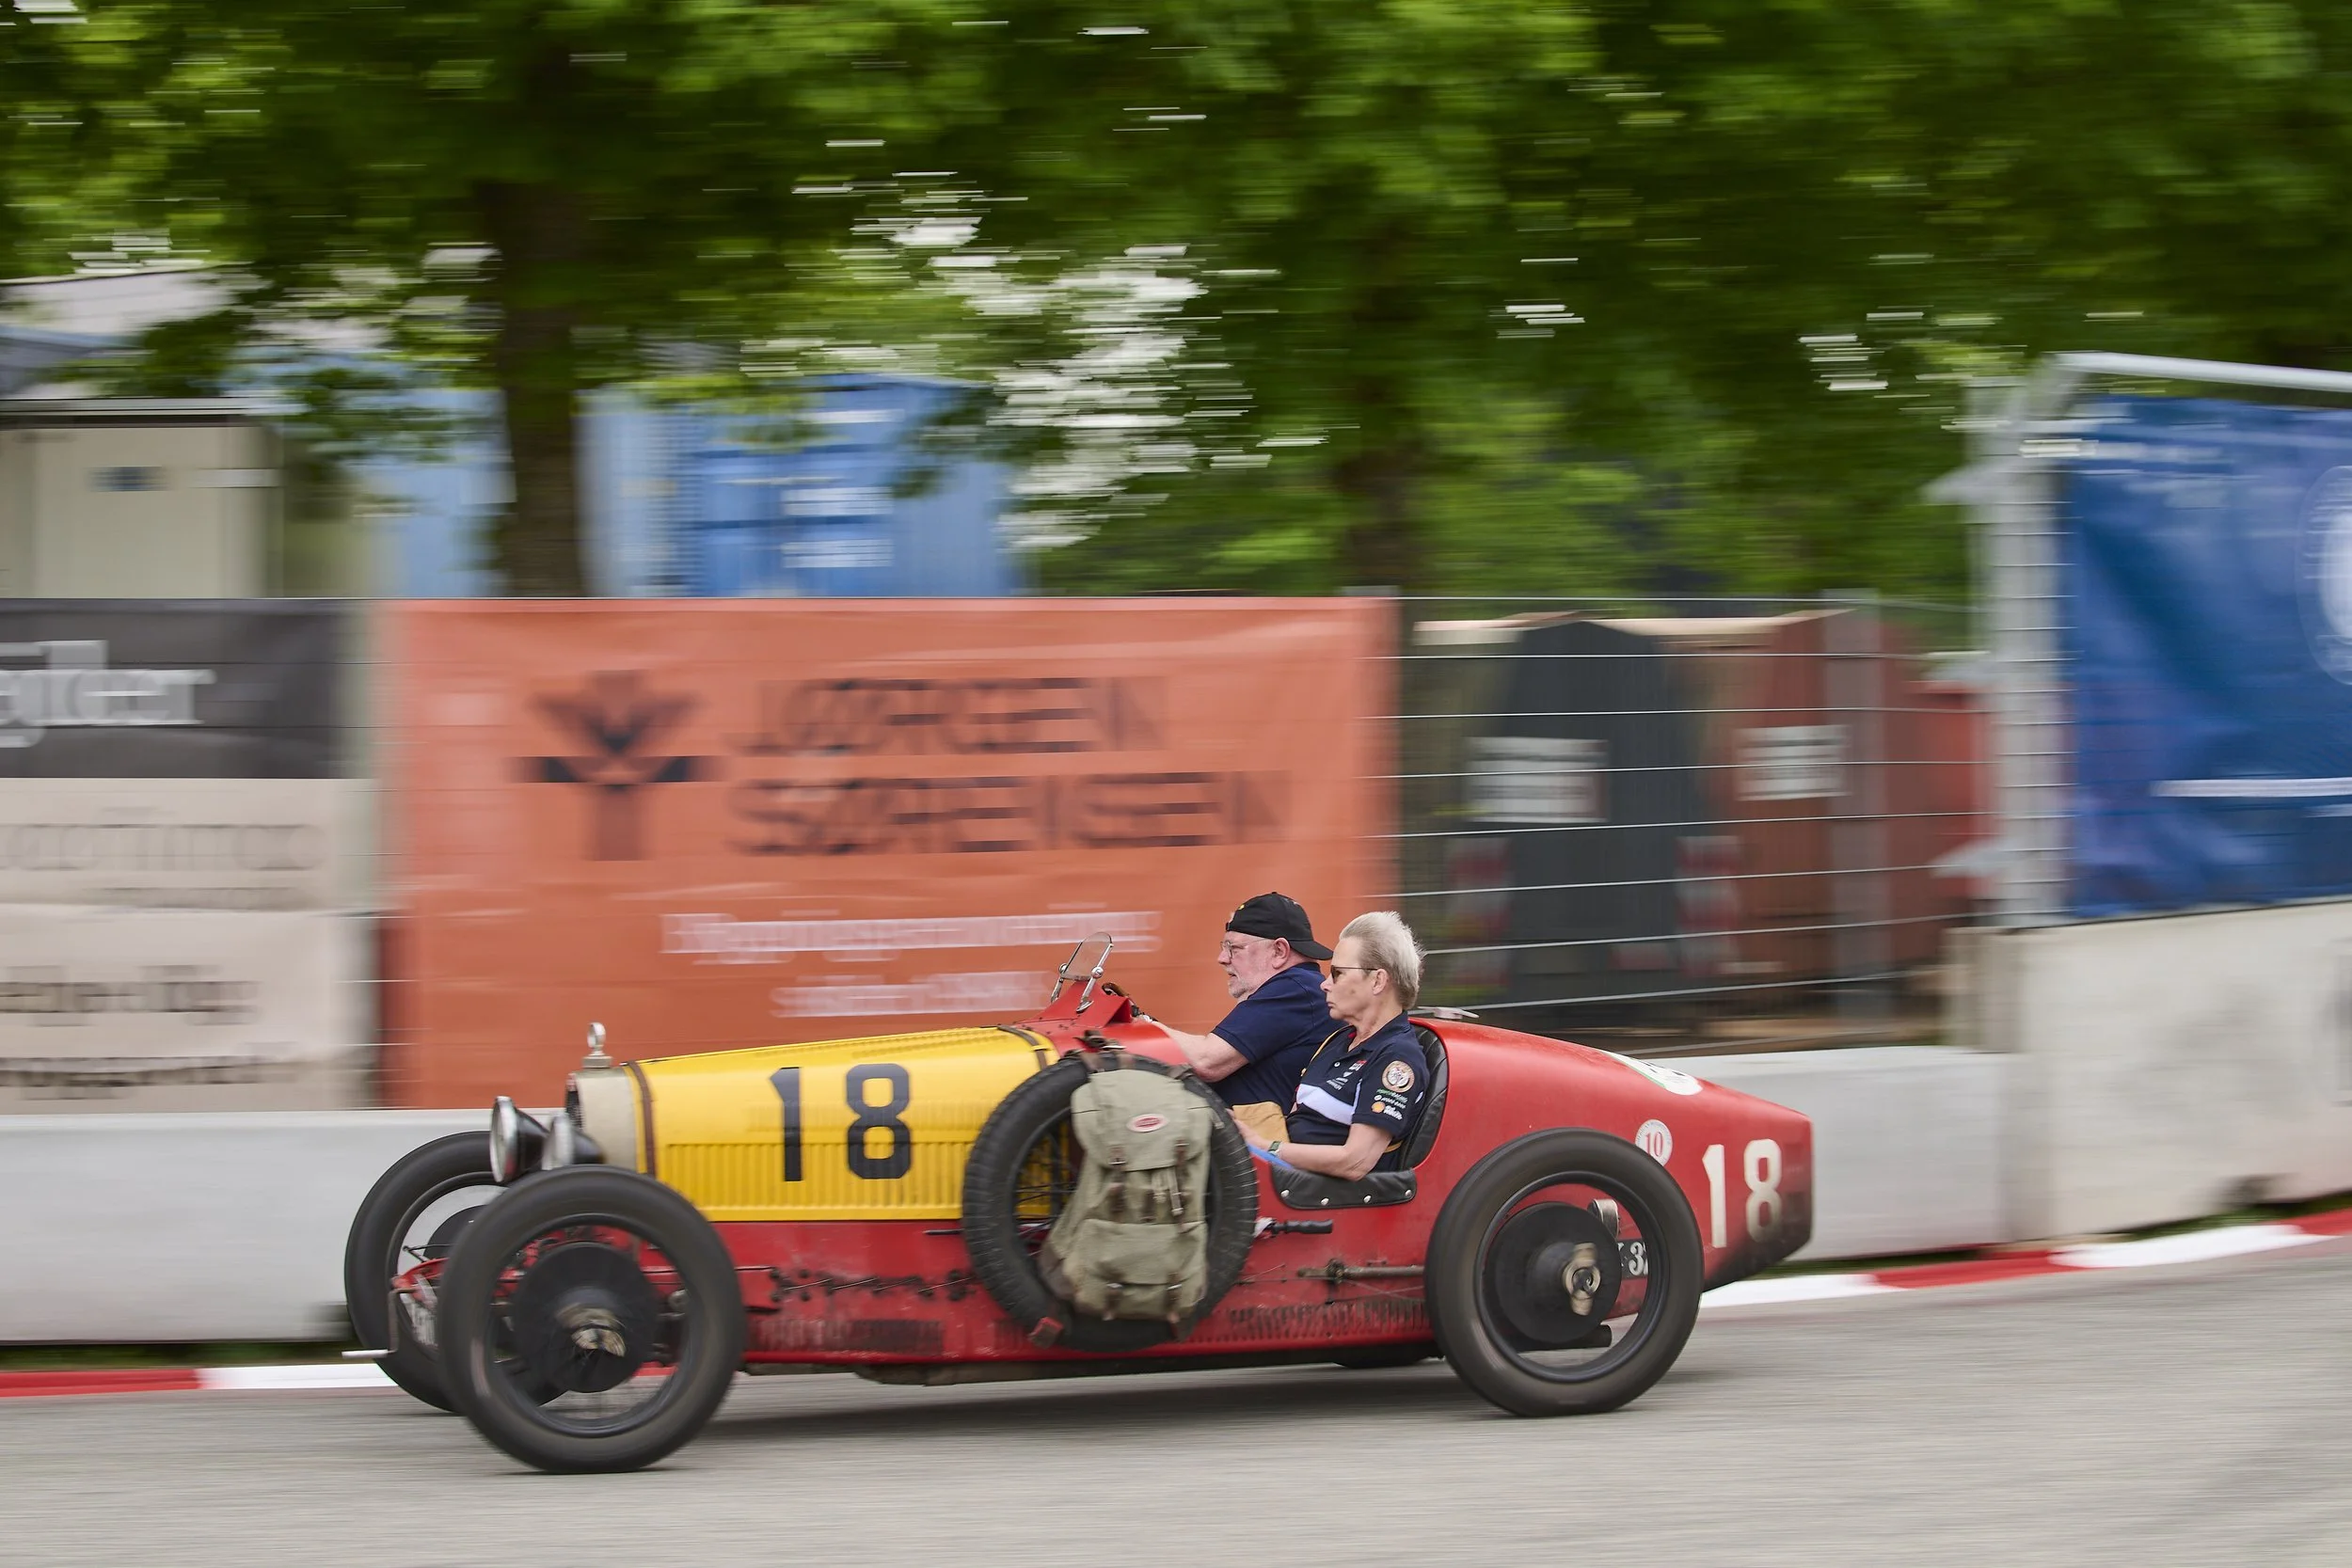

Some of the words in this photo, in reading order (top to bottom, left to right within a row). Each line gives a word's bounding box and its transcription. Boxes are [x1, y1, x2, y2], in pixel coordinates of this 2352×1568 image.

[769, 1063, 912, 1181] 18
[1645, 1132, 1663, 1157] 10
[1701, 1138, 1782, 1249] 18
